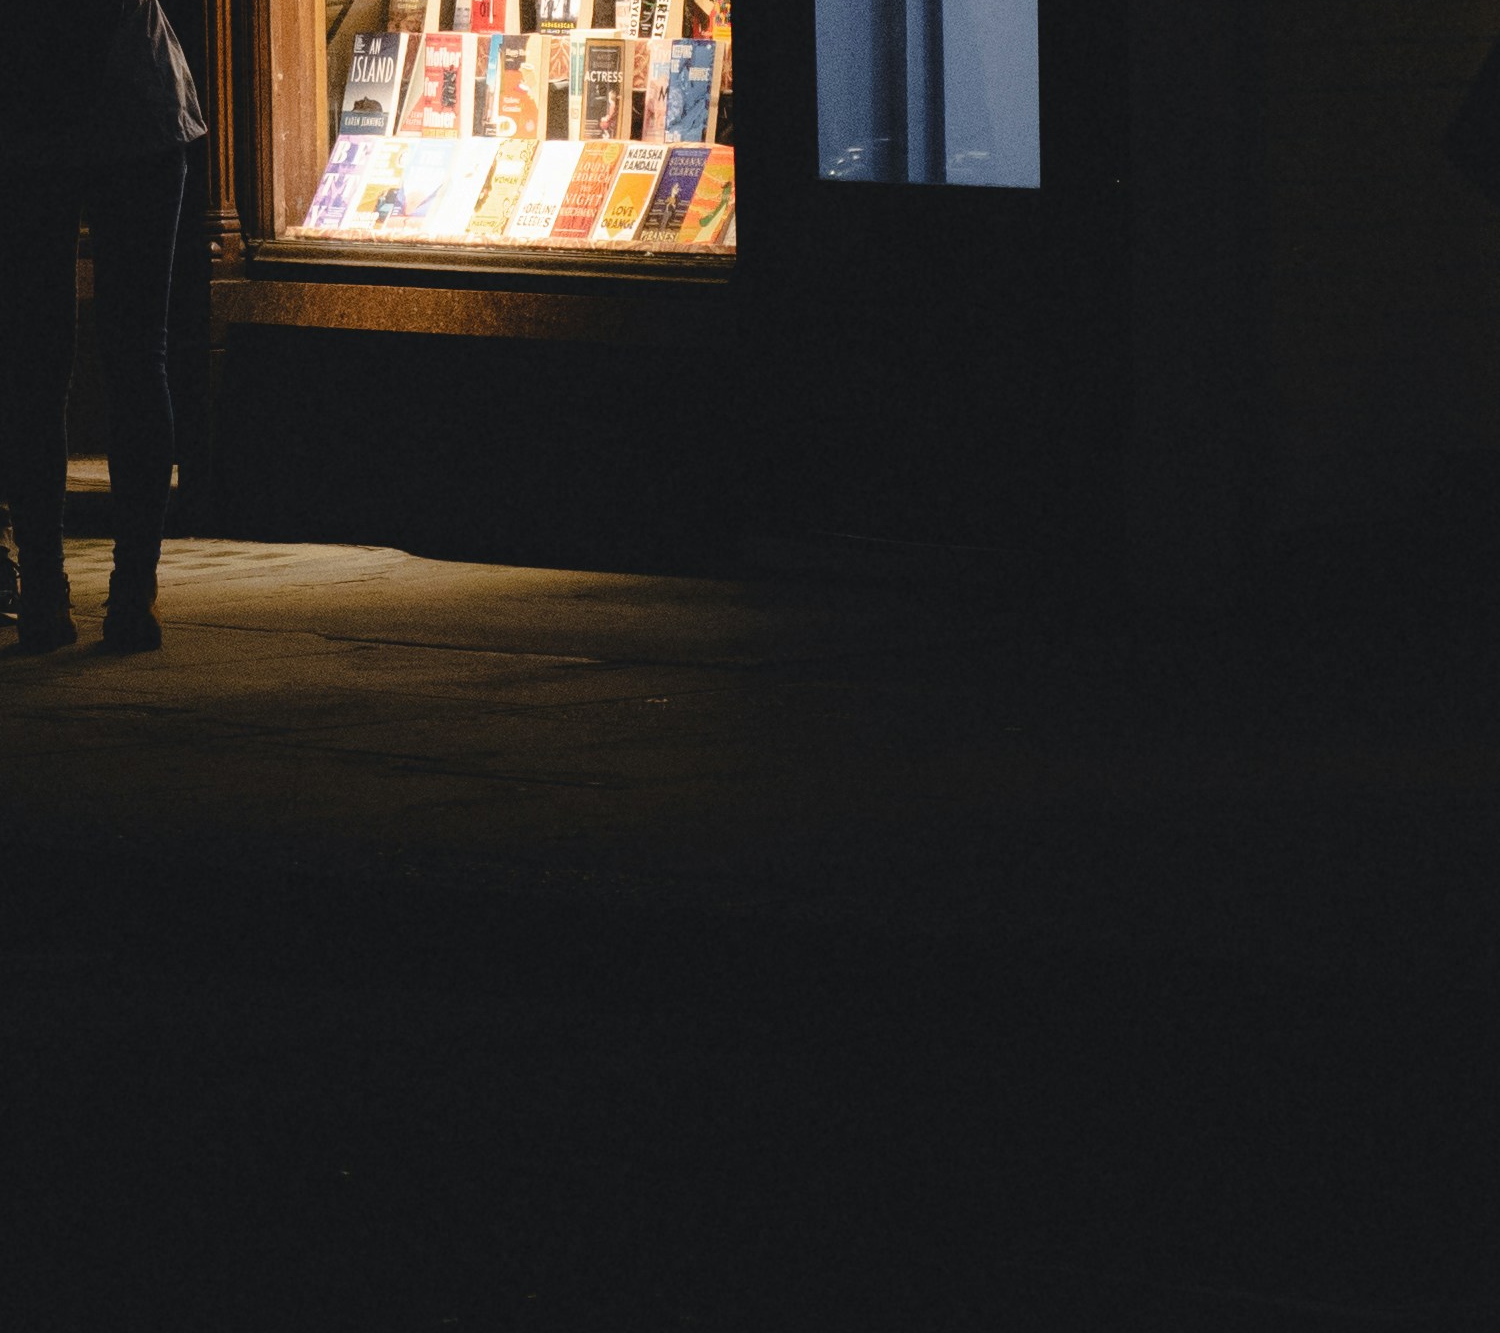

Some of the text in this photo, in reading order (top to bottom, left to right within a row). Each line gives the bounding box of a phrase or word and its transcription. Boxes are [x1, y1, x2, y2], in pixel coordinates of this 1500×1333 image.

[369, 37, 382, 55] AN
[425, 46, 461, 68] Mother
[350, 55, 395, 83] ISLAND
[584, 70, 624, 83] ACTRESS
[423, 76, 439, 97] for
[627, 147, 664, 160] NATASHA
[579, 161, 611, 172] LOUISE
[623, 160, 659, 172] RANDALL
[669, 167, 700, 177] CLARKE
[564, 194, 603, 207] NIGHT
[611, 205, 635, 216] LOVE
[600, 218, 636, 230] ORANGE
[640, 230, 679, 242] PIRANESI
